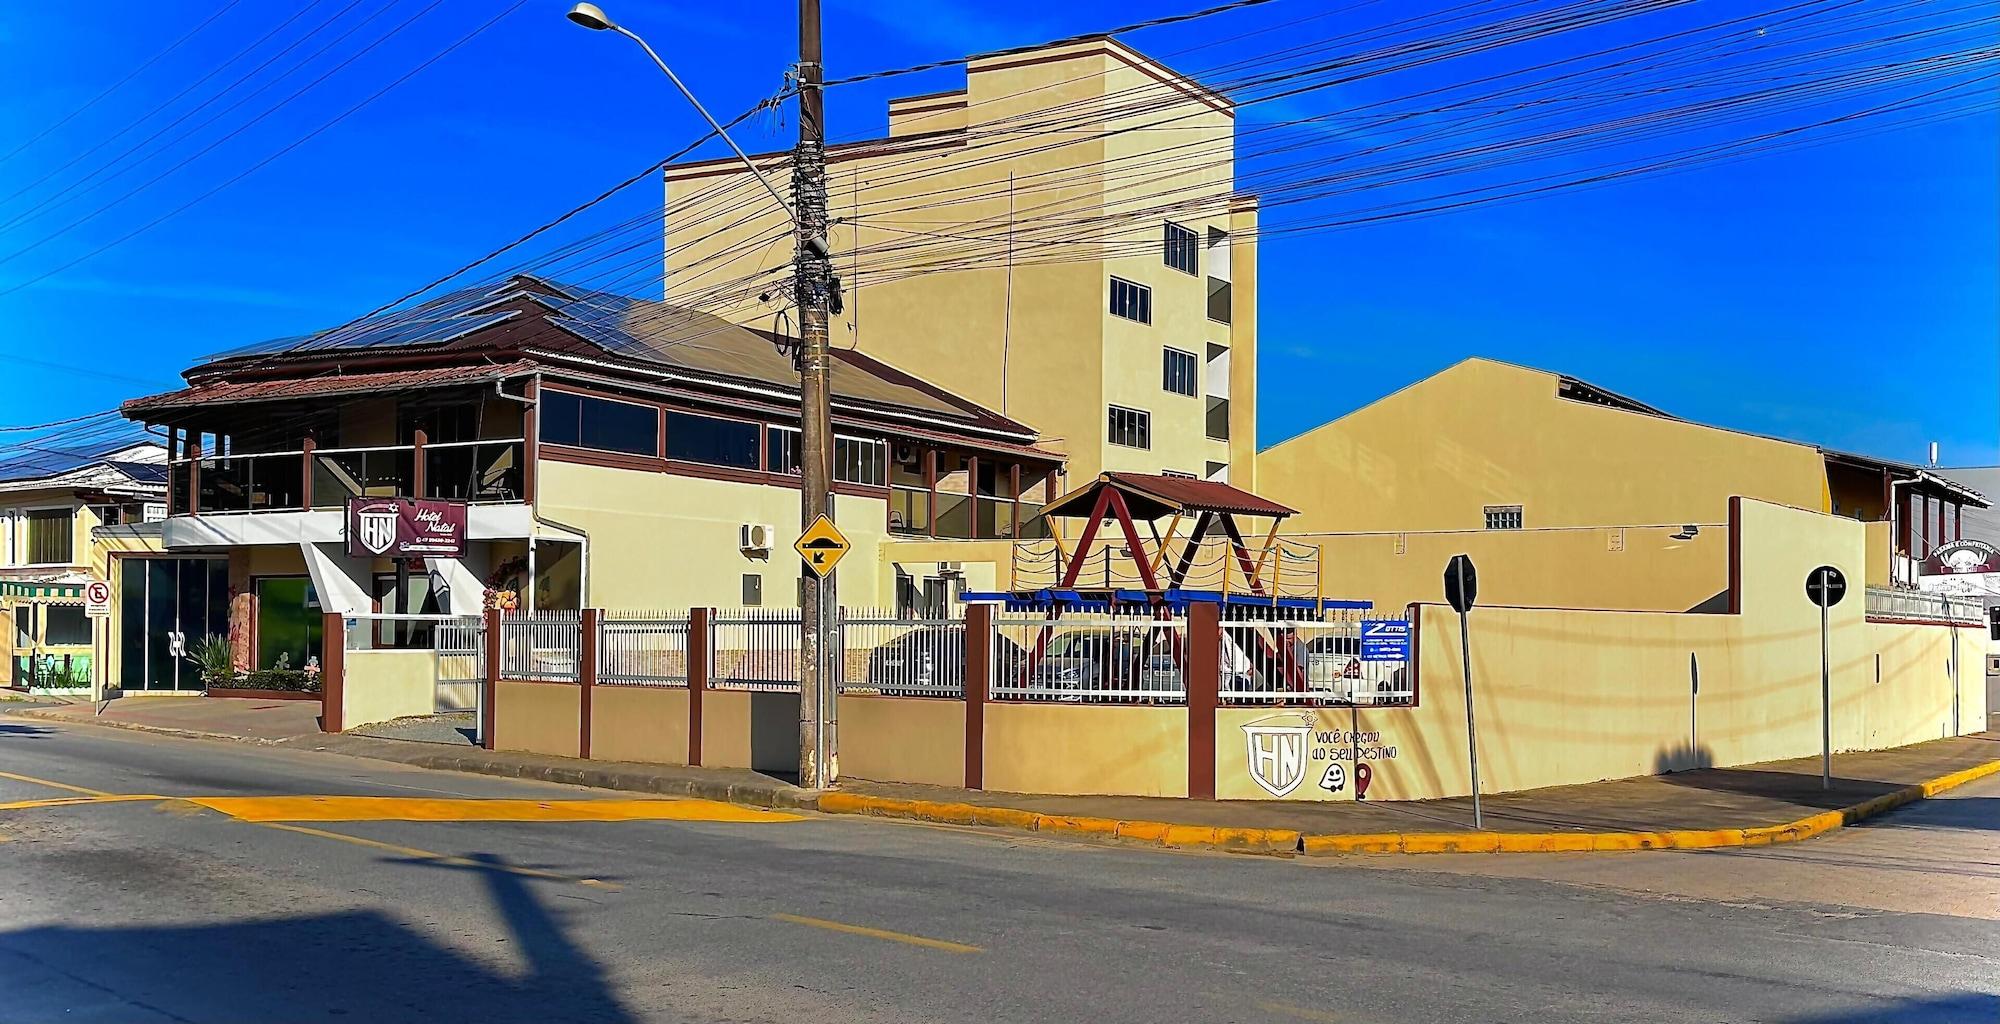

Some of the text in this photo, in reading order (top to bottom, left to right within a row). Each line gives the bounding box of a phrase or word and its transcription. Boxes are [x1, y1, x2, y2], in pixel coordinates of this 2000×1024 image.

[414, 508, 443, 521] Hotel
[365, 517, 392, 549] HN
[425, 522, 456, 533] Natal
[1254, 733, 1301, 789] HN
